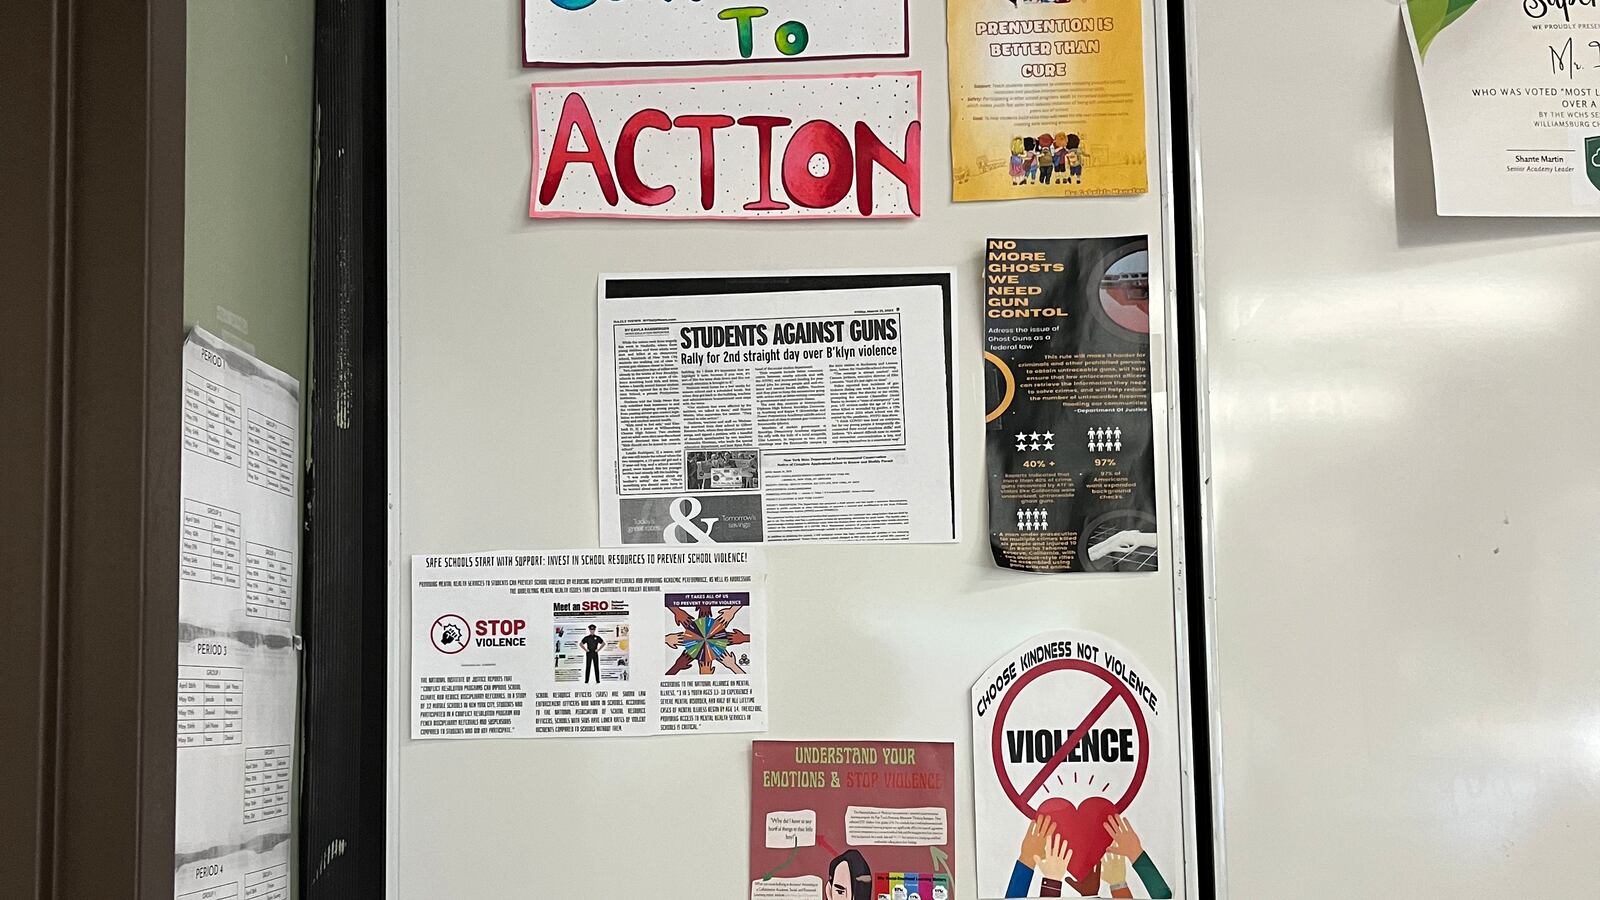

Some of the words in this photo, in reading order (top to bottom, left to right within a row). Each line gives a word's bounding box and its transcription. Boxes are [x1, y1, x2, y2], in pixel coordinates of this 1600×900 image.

[718, 6, 809, 58] To
[976, 18, 1094, 35] PRENVENTION
[1097, 17, 1113, 31] IS
[990, 42, 1052, 56] BETTER
[1054, 40, 1100, 54] THAN
[1549, 37, 1584, 79] Mr.
[1021, 63, 1066, 77] CURE
[538, 91, 921, 217] ACTION
[1526, 166, 1553, 174] Academy
[989, 241, 1016, 249] NO
[989, 253, 1046, 261] MORE
[988, 263, 1064, 272] GHOSTS
[989, 275, 1019, 284] WE
[988, 287, 1042, 295] NEED
[988, 298, 1028, 307] GUN
[988, 308, 1068, 318] CONTOL
[680, 324, 768, 349] STUDENTS
[773, 321, 844, 345] AGAINST
[850, 318, 897, 341] GUNS
[681, 353, 703, 366] Rally
[707, 352, 720, 363] for
[724, 351, 740, 363] 2nd
[743, 349, 780, 364] straight
[784, 348, 799, 362] day
[803, 350, 822, 359] over
[827, 347, 855, 359] B'klyn
[858, 345, 897, 357] violence
[1023, 460, 1045, 468] 40%
[663, 497, 719, 543] &
[426, 557, 441, 568] SAFE
[445, 557, 472, 567] SCHOOLS
[475, 557, 494, 567] START
[497, 556, 512, 566] WITH
[515, 556, 545, 566] SUPPORT:
[548, 556, 569, 565] INVEST
[572, 555, 578, 565] IN
[581, 555, 605, 565] SCHOOL
[608, 554, 645, 564] RESOURCES
[646, 554, 655, 564] TO
[657, 554, 685, 564] PREVENT
[688, 553, 711, 563] SCHOOL
[714, 553, 747, 563] VIOLENCE!
[554, 603, 571, 611] Meet
[582, 601, 609, 610] SRO
[475, 620, 526, 636] STOP
[198, 644, 222, 655] PERIOD
[476, 638, 526, 647] VIOLENCE
[977, 662, 1017, 717] CHOOSE
[1020, 641, 1072, 671] KINDNESS
[1077, 643, 1099, 662] NOT
[1105, 652, 1159, 715] VIOLENCE.
[1007, 729, 1134, 763] VIOLENCE
[795, 747, 877, 765] UNDERSTAND
[883, 748, 915, 765] YOUR
[763, 771, 825, 788] EMOTIONS
[831, 772, 840, 788] &
[847, 772, 878, 787] STOP
[884, 773, 940, 789] VIOLENCE
[196, 865, 218, 879] PERIOD
